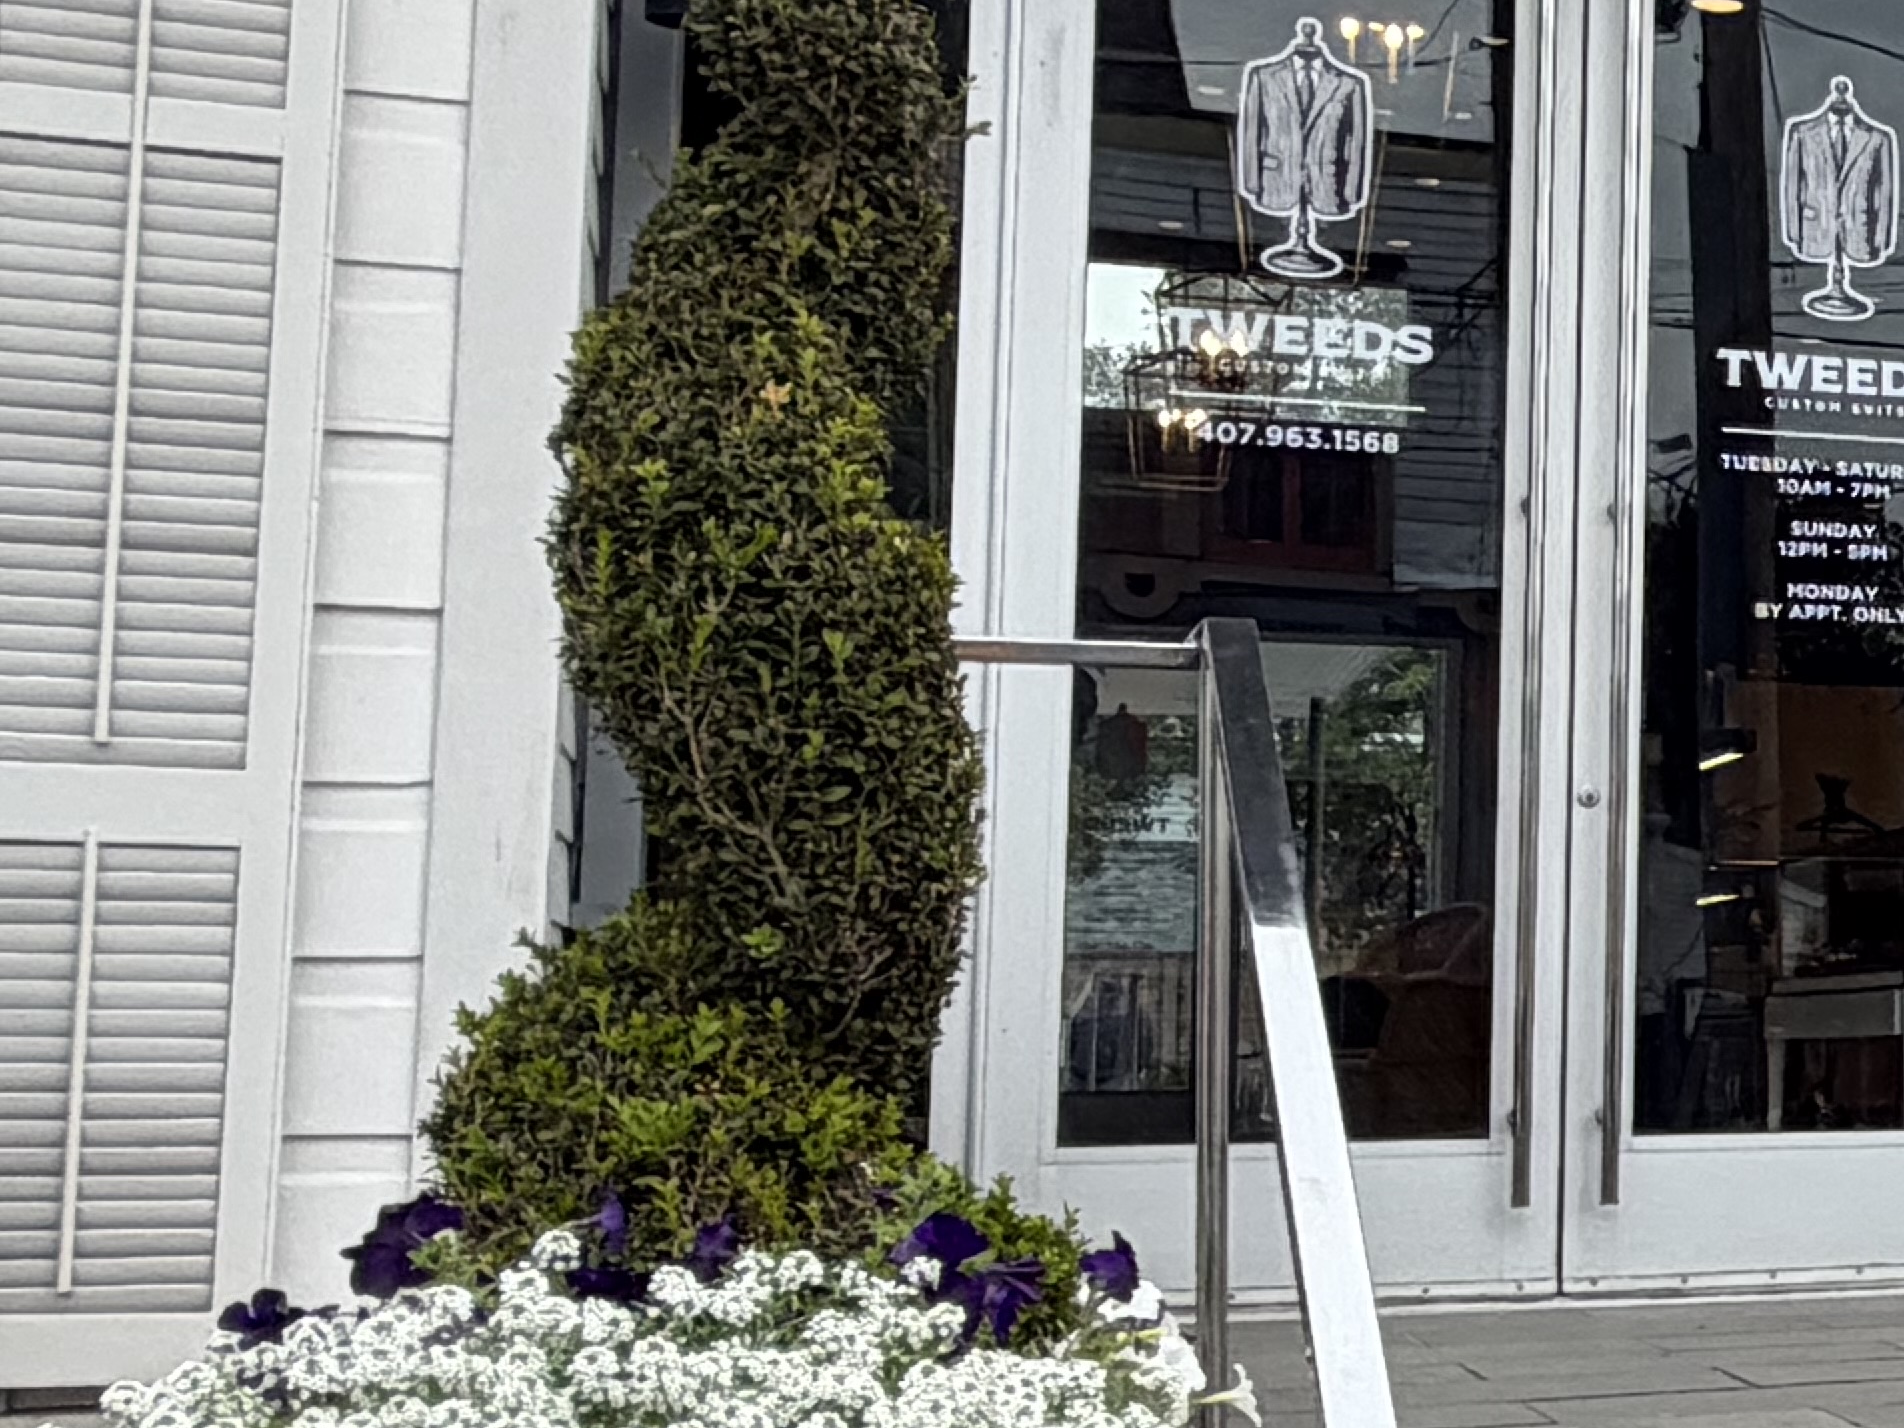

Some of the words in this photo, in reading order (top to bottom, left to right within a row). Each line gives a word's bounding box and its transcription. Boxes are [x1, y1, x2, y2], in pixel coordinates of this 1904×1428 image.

[1166, 306, 1434, 364] TWEEDS
[1764, 396, 1842, 413] CUSTOM
[1197, 421, 1400, 454] 407.963.1568
[1720, 453, 1818, 474] TUESDAY
[1777, 478, 1832, 496] 10AM
[1850, 482, 1892, 500] 7PM
[1790, 520, 1877, 539] SUNDAY
[1778, 541, 1828, 559] 12PM
[1786, 583, 1880, 602] MONDAY
[1754, 603, 1783, 619] BY
[1788, 604, 1848, 621] APPT.
